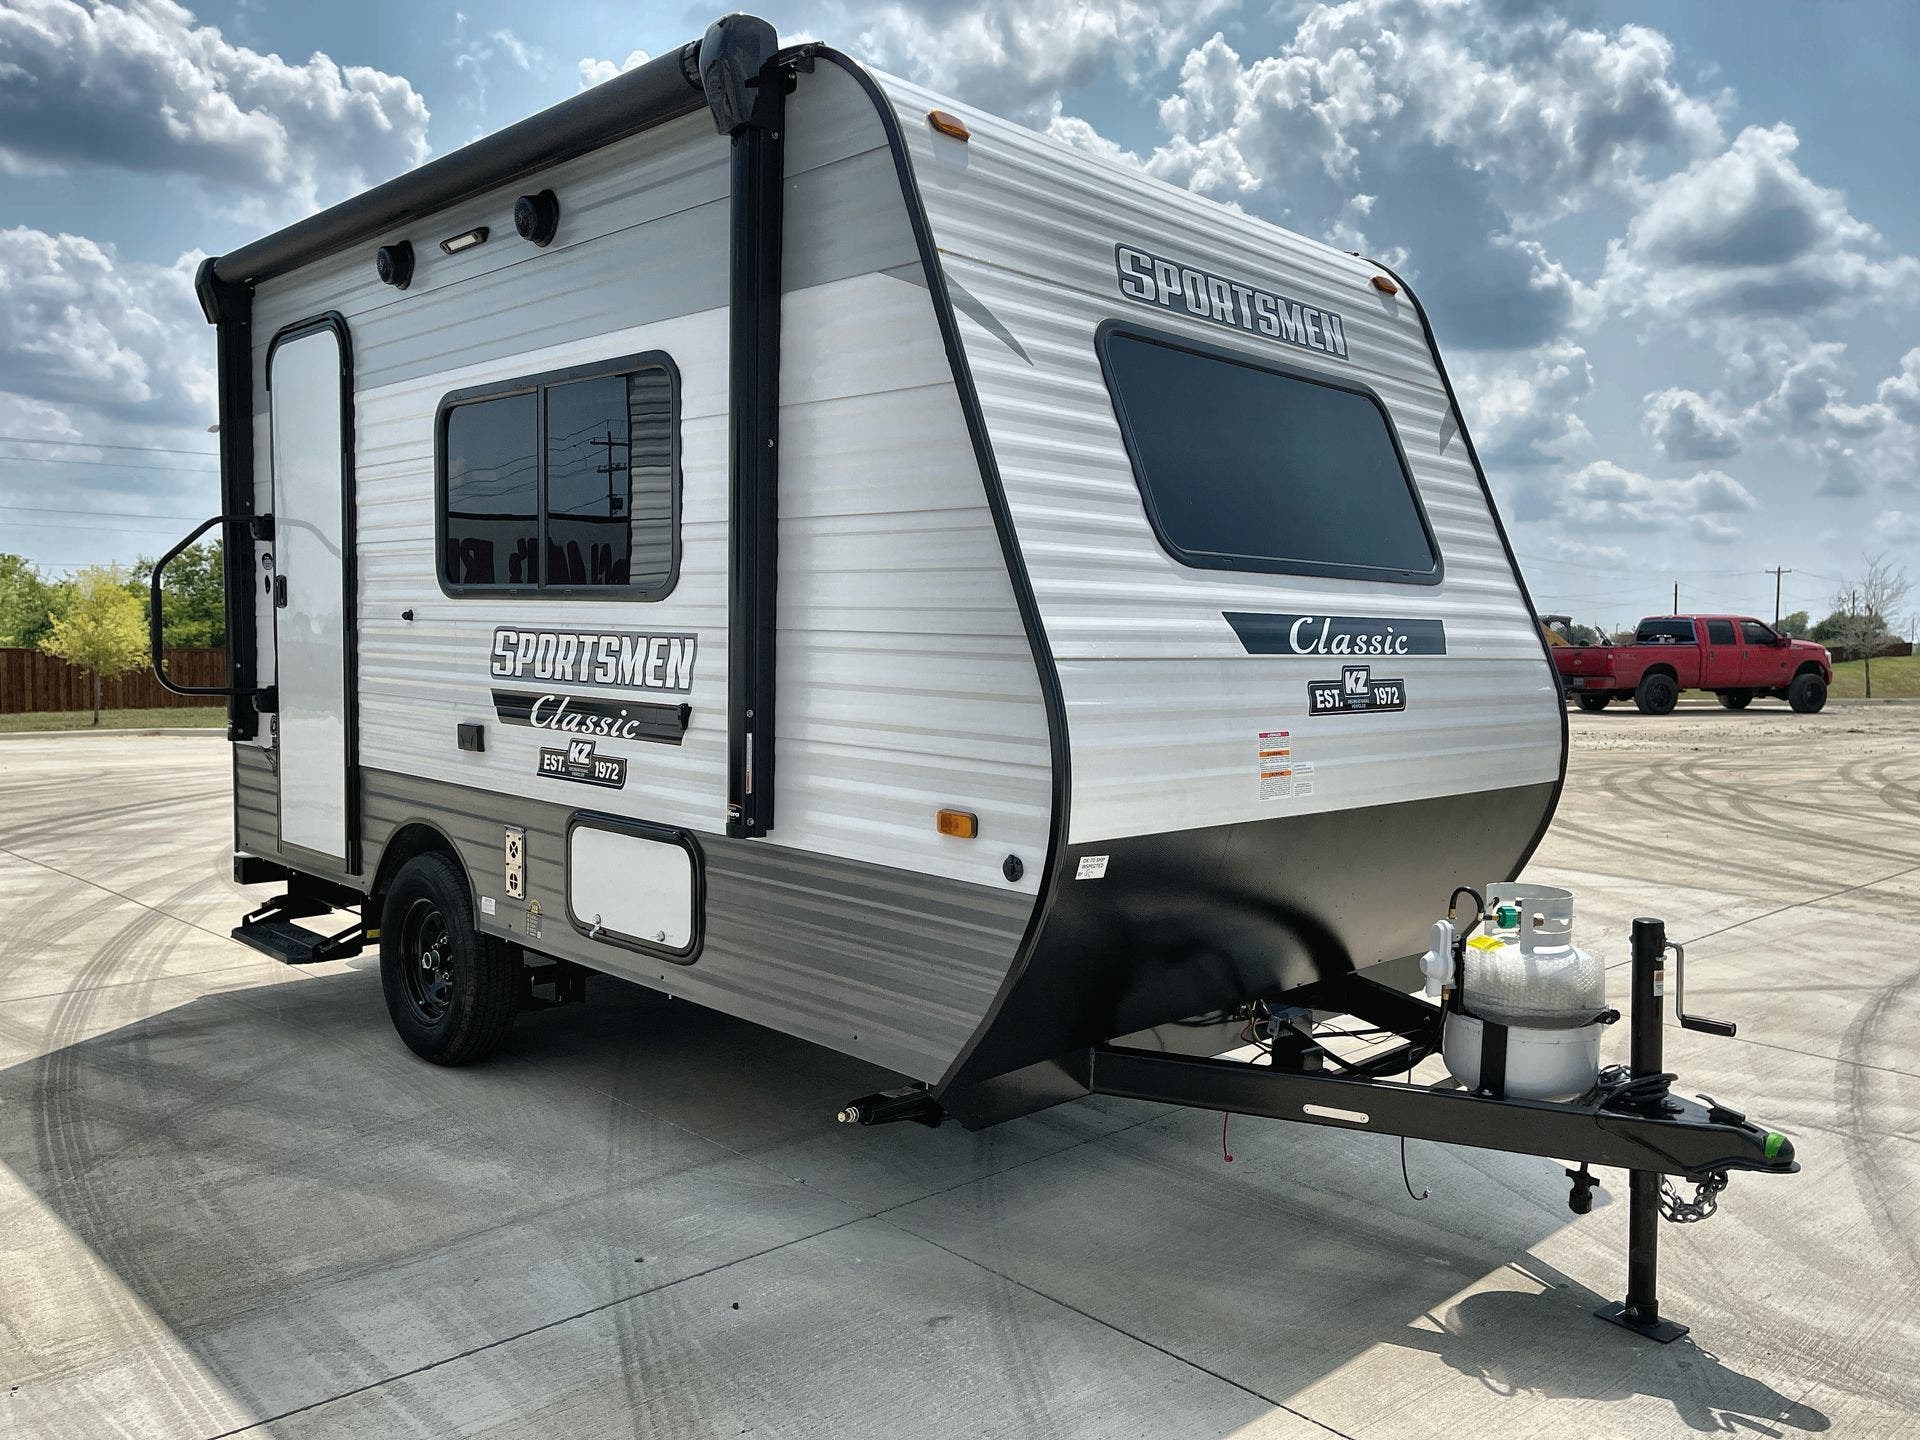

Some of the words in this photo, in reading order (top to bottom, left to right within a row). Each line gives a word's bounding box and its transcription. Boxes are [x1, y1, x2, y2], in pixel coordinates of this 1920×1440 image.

[1116, 245, 1347, 358] SPORTSMEN
[1288, 616, 1410, 656] Classic
[491, 629, 696, 690] SPORTSMEN
[1315, 688, 1344, 709] EST.
[1373, 686, 1400, 706] 1972
[1344, 670, 1368, 694] KZ
[530, 694, 641, 740] Classic
[543, 753, 566, 772] EST.
[594, 760, 620, 781] 1972
[569, 741, 593, 765] KZ
